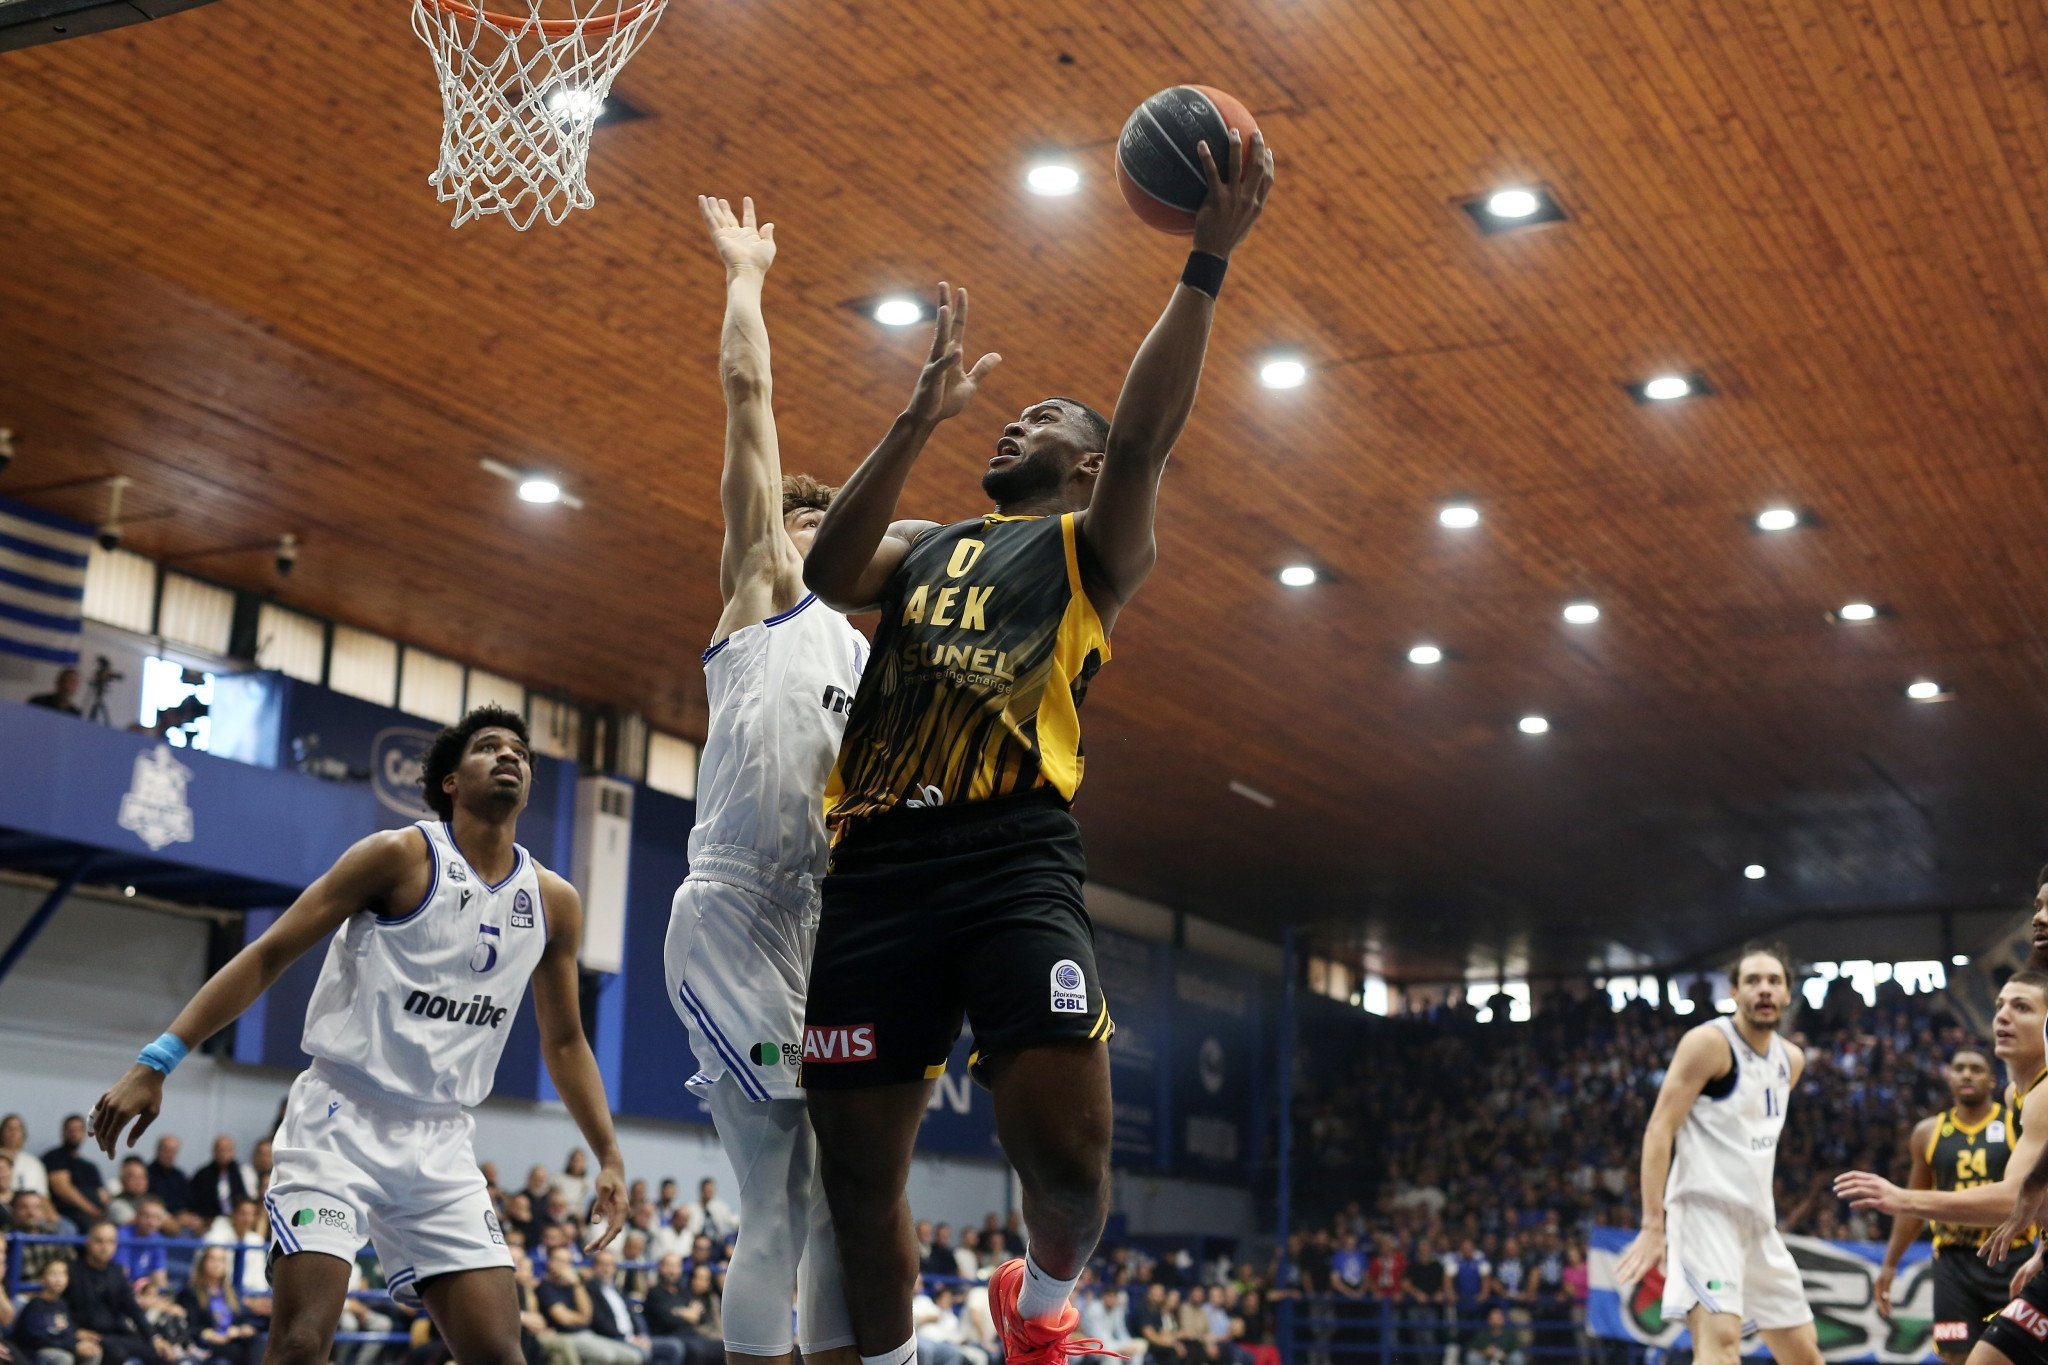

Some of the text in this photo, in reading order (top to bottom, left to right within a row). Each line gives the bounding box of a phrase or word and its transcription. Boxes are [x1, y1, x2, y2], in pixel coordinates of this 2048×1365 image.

[946, 538, 986, 578] 0
[902, 585, 995, 631] AEK
[903, 642, 1015, 681] SUNEL
[966, 674, 1013, 696] Change
[512, 916, 533, 927] GBL
[470, 923, 500, 973] 5
[403, 990, 508, 1029] novibe
[1054, 998, 1085, 1010] GBL
[803, 1027, 873, 1059] AVIS
[1766, 1088, 1779, 1117] 11
[1957, 1147, 1987, 1179] 24
[319, 1208, 346, 1220] eco
